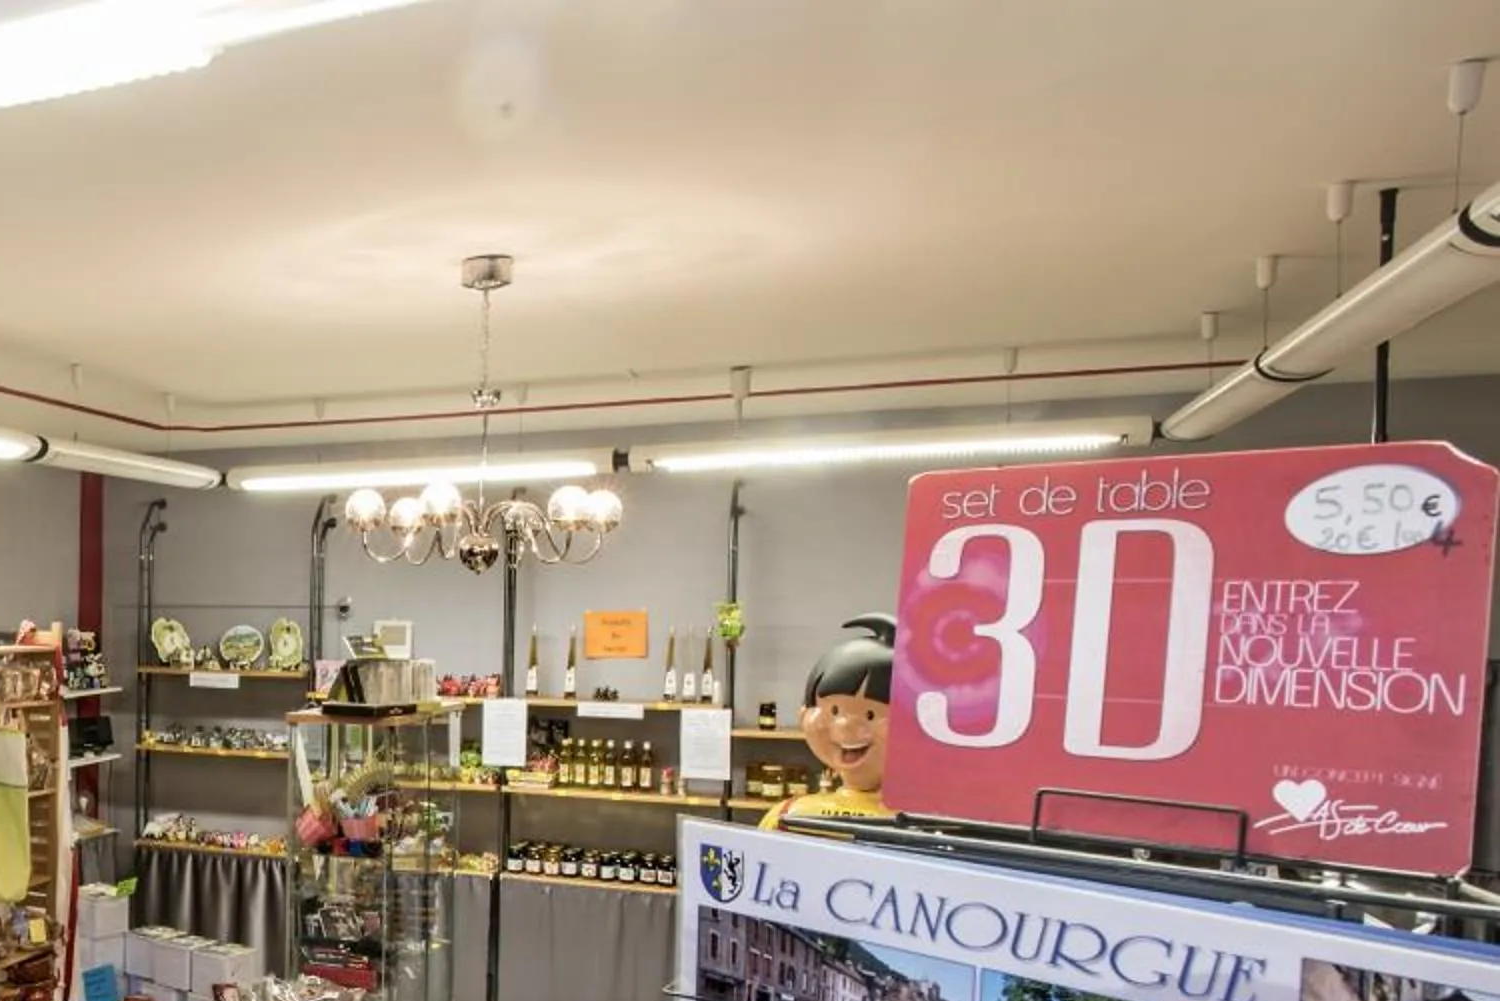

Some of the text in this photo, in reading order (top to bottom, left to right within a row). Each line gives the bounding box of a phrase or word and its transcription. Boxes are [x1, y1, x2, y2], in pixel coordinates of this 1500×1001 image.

[943, 468, 1210, 519] set de table
[1222, 580, 1360, 614] ENTREZ
[1219, 613, 1330, 636] DANS LA
[1218, 634, 1418, 672] NOUVELLE
[1215, 664, 1467, 716] DIMENSION
[751, 861, 801, 911] La
